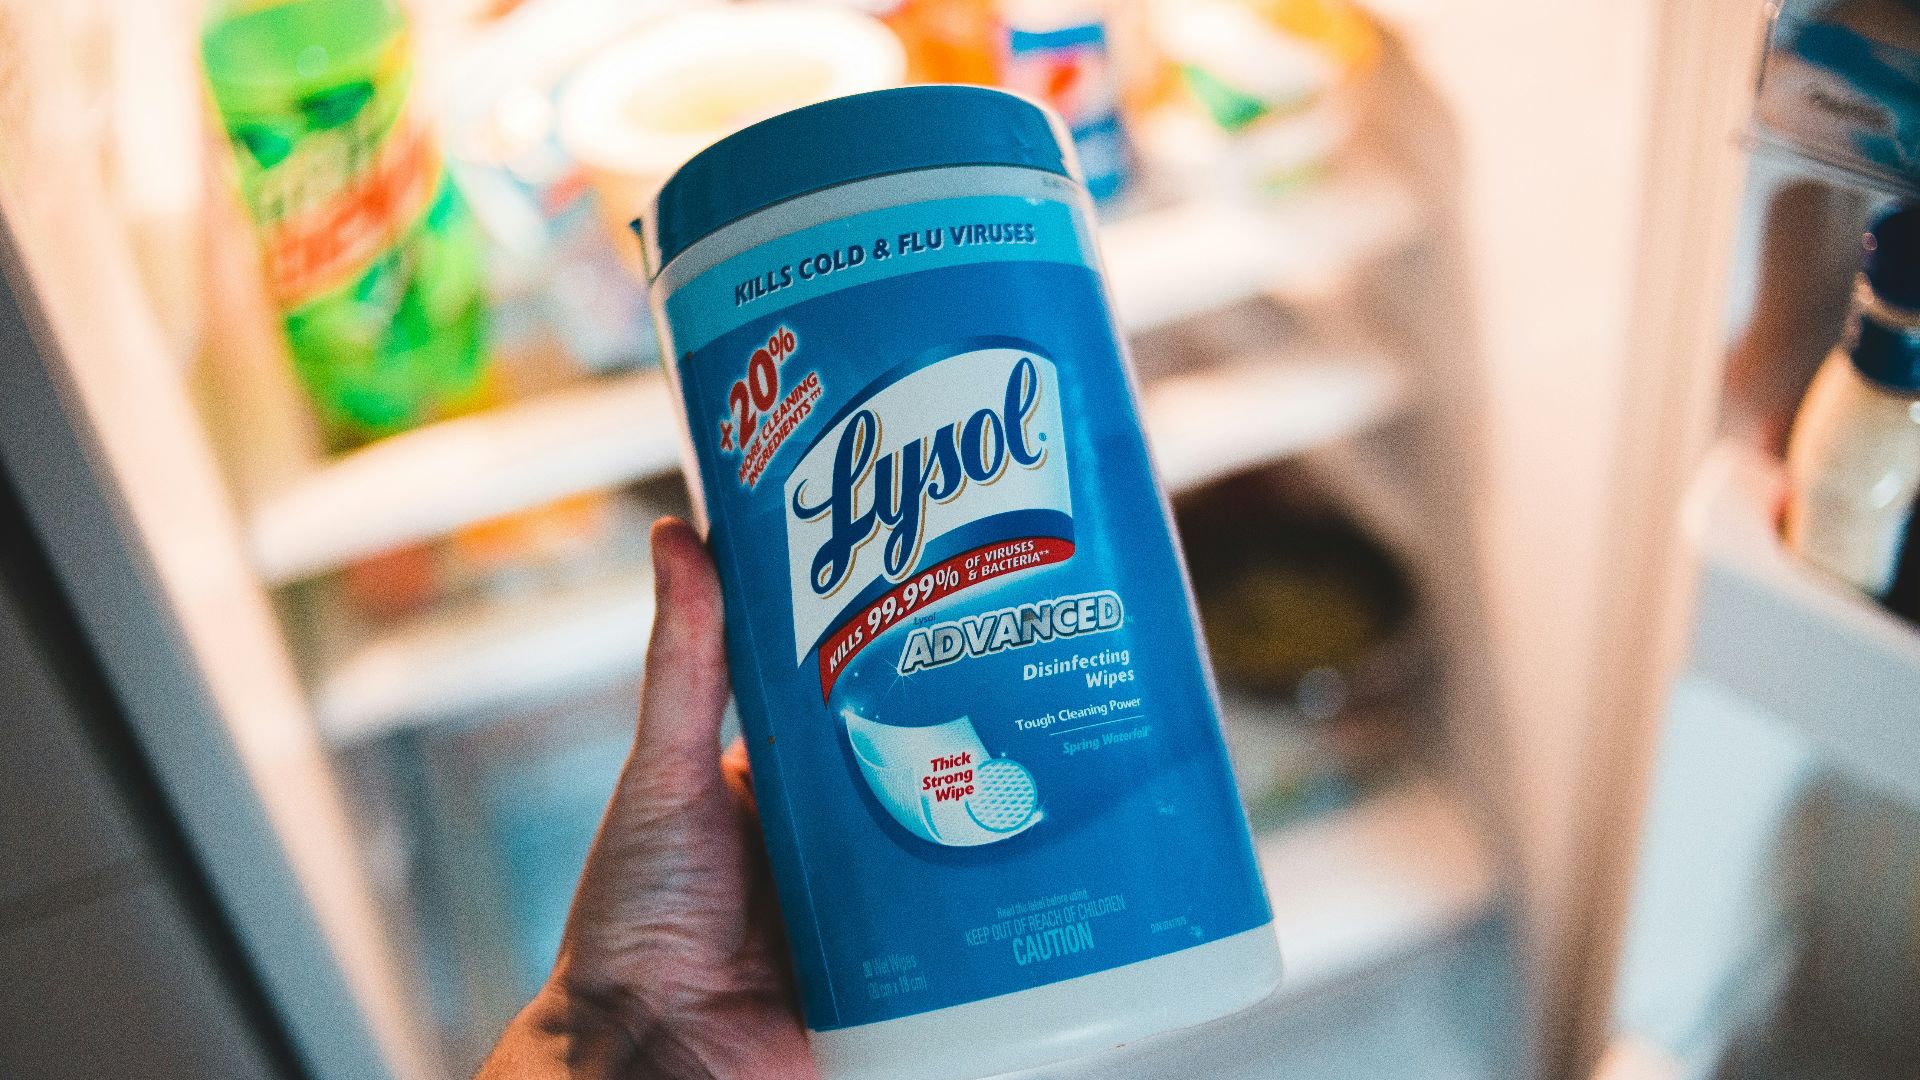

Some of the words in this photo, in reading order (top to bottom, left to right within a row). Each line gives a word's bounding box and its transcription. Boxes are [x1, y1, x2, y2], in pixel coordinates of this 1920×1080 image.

[734, 265, 793, 307] KILLS
[799, 245, 866, 281] COLD
[872, 238, 892, 260] &
[898, 228, 944, 255] FLU
[950, 223, 1036, 247] VIRUSES
[739, 436, 761, 484] MORE
[762, 372, 817, 440] CLEANING
[965, 555, 981, 569] OF
[984, 540, 1034, 562] VIRUSES
[968, 570, 977, 581] &
[829, 625, 863, 673] KILLS
[867, 566, 959, 635] 99.99%
[899, 591, 1123, 675] ADVANCED
[914, 612, 937, 625] Lysol
[1023, 649, 1130, 681] Disinfecting
[1085, 669, 1134, 688] Wipes
[1015, 713, 1055, 730] Tough
[1058, 704, 1107, 721] Cleaning
[1109, 698, 1141, 711] Power
[1063, 738, 1099, 755] Spring
[931, 752, 971, 772] Thick
[922, 769, 973, 791] Strong
[935, 784, 974, 802] Wipe
[964, 926, 989, 946] KEEP
[992, 920, 1012, 940] OUT
[1013, 917, 1026, 935] OF
[1028, 909, 1063, 932] REACH
[1064, 905, 1076, 923] OF
[1077, 894, 1126, 920] CHILDREN
[1012, 921, 1094, 966] CAUTION
